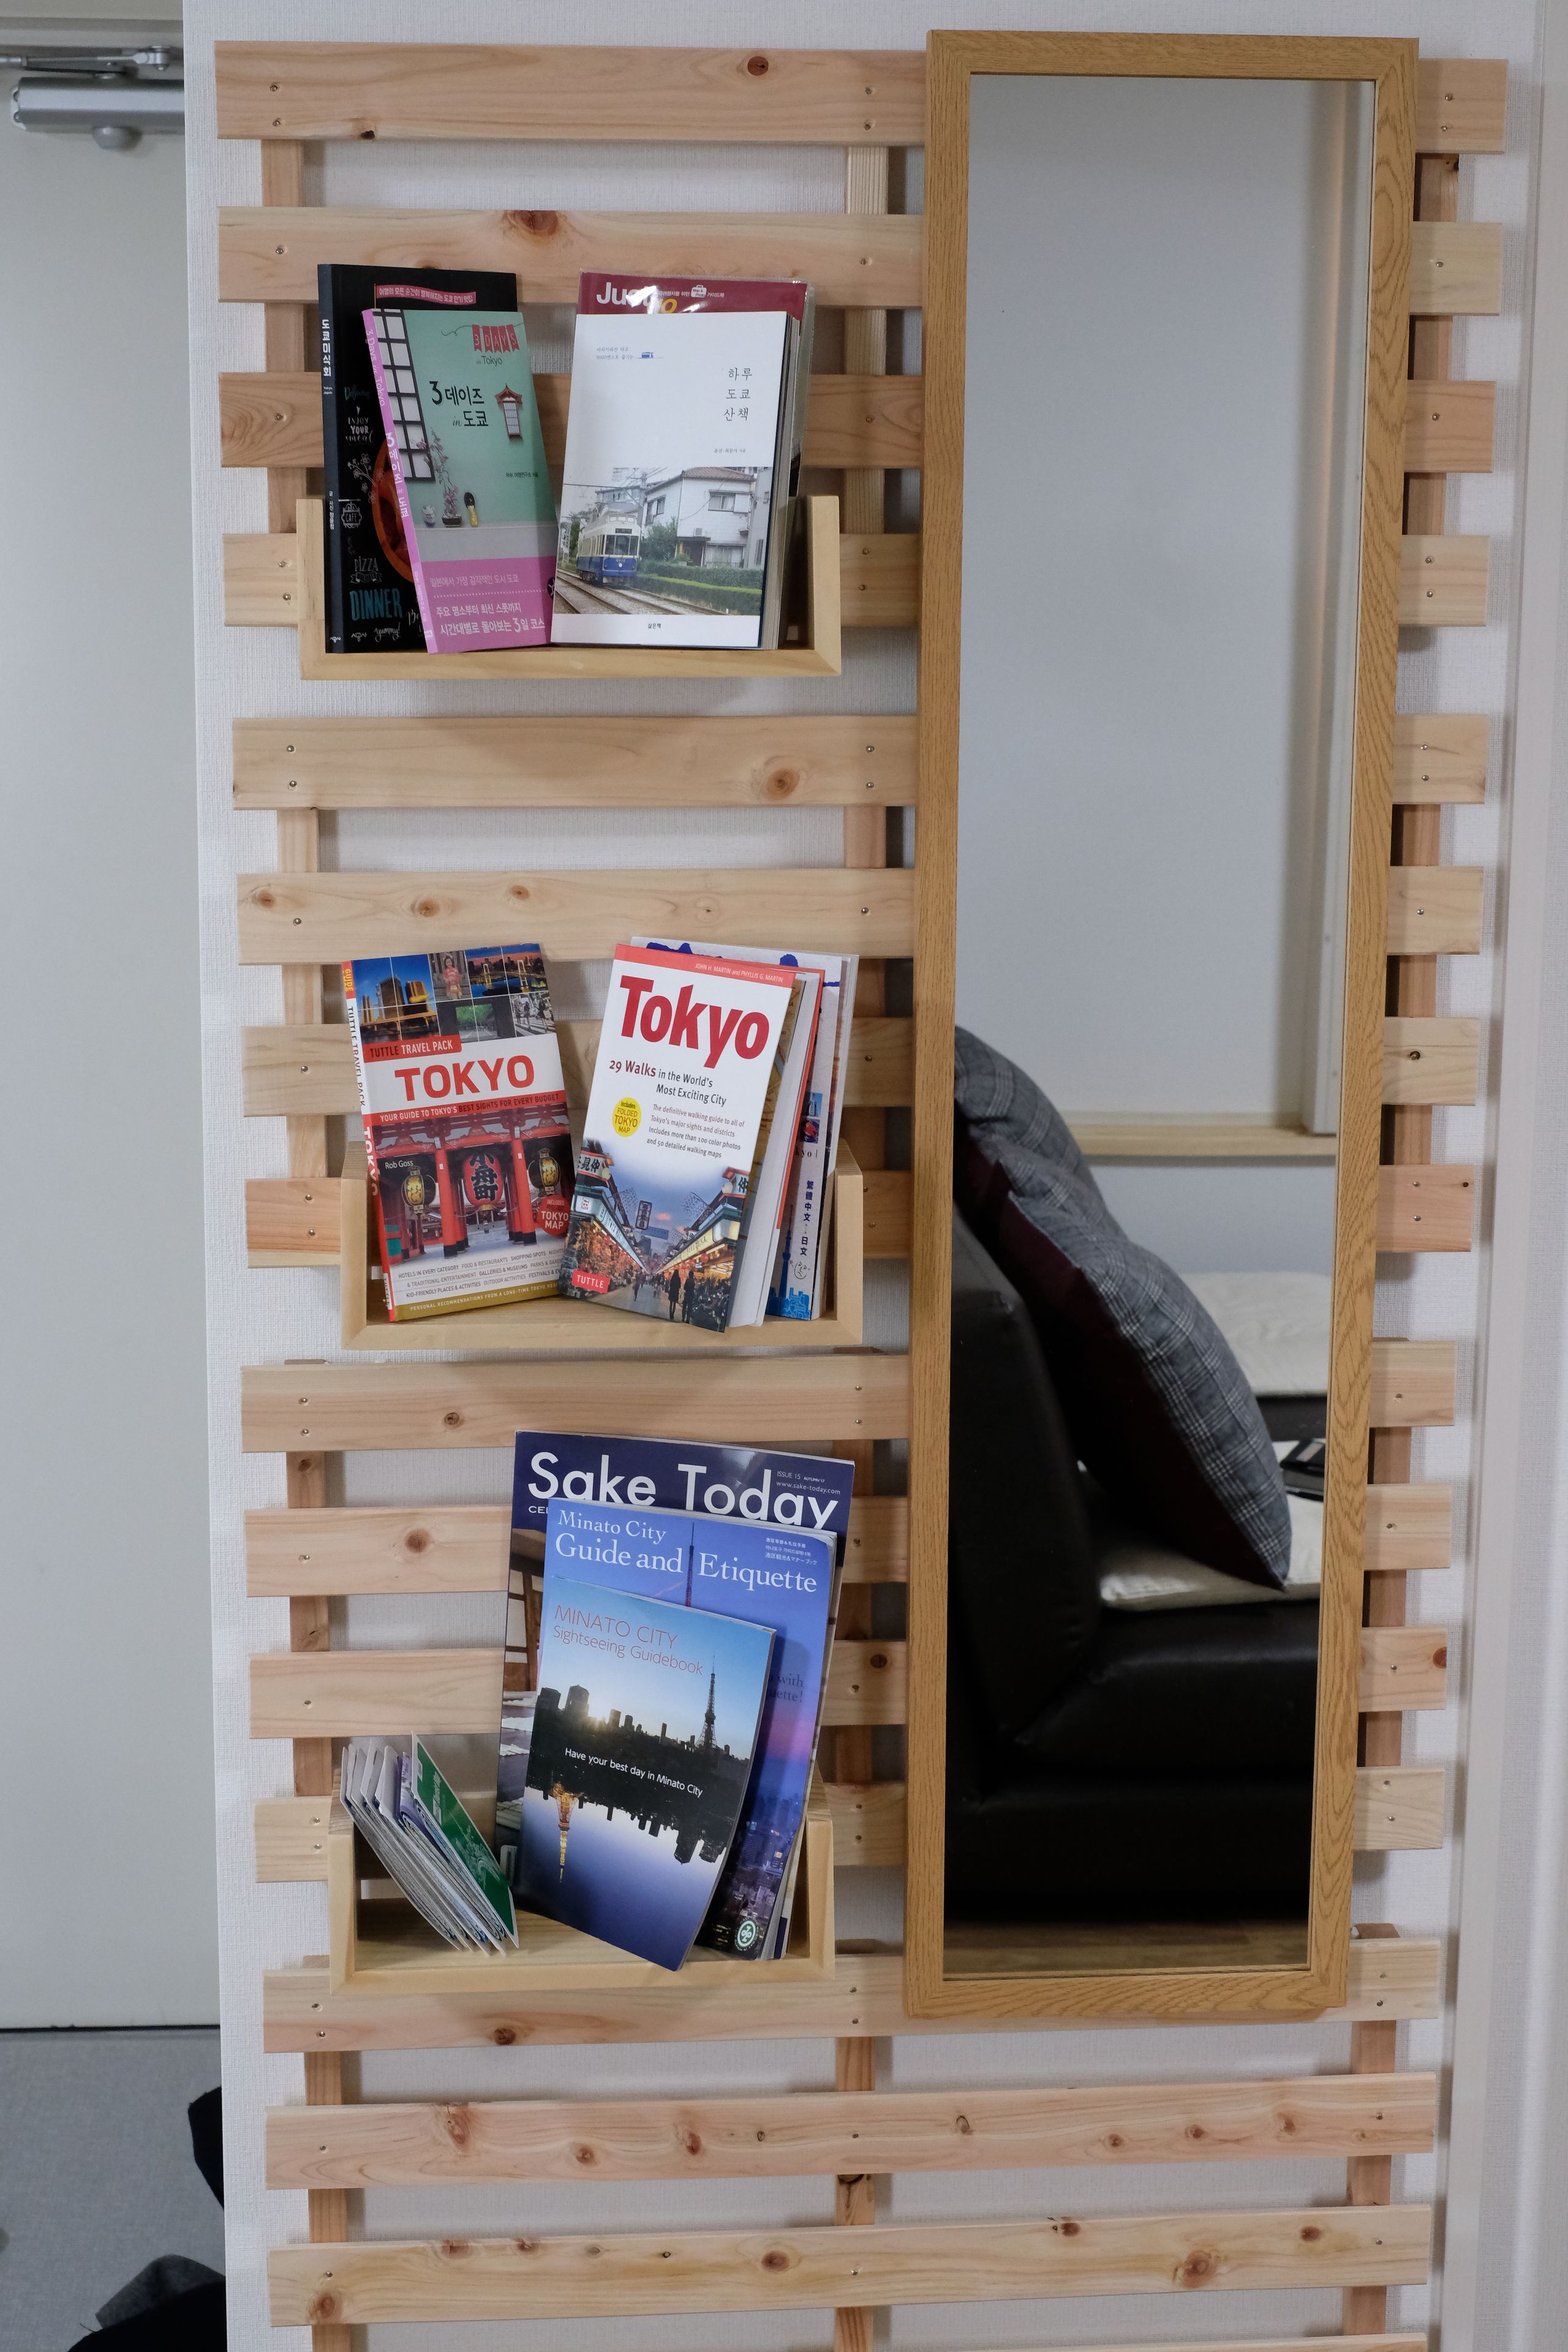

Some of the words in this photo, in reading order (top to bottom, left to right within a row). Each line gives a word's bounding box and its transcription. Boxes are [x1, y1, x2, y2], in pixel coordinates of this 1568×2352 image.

[475, 334, 480, 345] 3
[485, 334, 516, 346] DAYS
[368, 338, 377, 361] Days
[481, 356, 502, 366] Tokyo
[728, 368, 752, 381] 하루
[429, 381, 442, 405] 3
[445, 385, 484, 405] 데이즈
[726, 389, 750, 399] 도쿄
[453, 417, 461, 426] in
[464, 411, 488, 426] 도쿄
[723, 407, 748, 421] 산책
[350, 426, 369, 434] YOUR
[386, 432, 394, 447] 3
[389, 448, 403, 484] 데이즈
[431, 577, 454, 587] 일본에서
[456, 577, 468, 586] 가장
[469, 575, 492, 586] 감각적인
[350, 588, 402, 621] DINNER
[436, 606, 451, 617] 주요
[452, 605, 479, 616] 명소부터
[481, 604, 494, 614] 최신
[441, 622, 480, 636] 시간대별로
[481, 620, 512, 633] 돌아보는
[513, 618, 529, 633] 3일
[530, 618, 545, 628] 코스
[619, 975, 769, 1069] Tokyo
[370, 1046, 398, 1058] TUTTLE
[401, 1042, 431, 1055] TRAVEL
[432, 1040, 453, 1051] PACK
[394, 1055, 534, 1101] TOKYO
[609, 1060, 622, 1073] 29
[625, 1060, 657, 1077] Walks
[658, 1069, 666, 1079] in
[668, 1071, 680, 1082] the
[683, 1073, 713, 1088] World's
[514, 1097, 532, 1106] EVERY
[535, 1093, 559, 1102] BUDGET
[656, 1084, 676, 1096] Most
[677, 1087, 709, 1104] Exciting
[710, 1094, 726, 1107] City
[617, 1107, 638, 1117] FOLDED
[663, 1106, 687, 1117] definitive
[688, 1112, 708, 1121] walking
[614, 1115, 638, 1128] TOKYO
[651, 1115, 669, 1125] Tokyo's
[714, 1128, 735, 1137] districts
[649, 1126, 670, 1136] Includes
[722, 1142, 741, 1150] photos
[665, 1141, 686, 1151] detailed
[687, 1147, 707, 1156] walking
[803, 1180, 814, 1222] 繁體中文
[541, 1210, 568, 1221] TOKYO
[545, 1220, 564, 1230] MAP
[800, 1236, 809, 1256] 日文
[412, 1278, 440, 1287] TRADITIONAL
[441, 1272, 477, 1283] ENTERTAINMENT
[479, 1267, 502, 1276] GALLERIES
[577, 1275, 604, 1288] TUTTLE
[406, 1289, 437, 1297] KID-FRIENDLY
[437, 1295, 483, 1306] RECOMMENDATIONS
[527, 1452, 657, 1507] Sake
[677, 1463, 839, 1529] Today
[776, 1482, 840, 1494] www.sake-today.com
[557, 1509, 621, 1534] Minato
[625, 1520, 667, 1544] City
[555, 1533, 631, 1566] Guide
[636, 1548, 684, 1574] and
[697, 1552, 818, 1594] Etiquette
[554, 1604, 631, 1638] MINATO
[636, 1626, 678, 1650] CITY
[553, 1625, 627, 1659] Sightseeing
[630, 1646, 704, 1676] Guidebook
[778, 1673, 804, 1687] with
[565, 1747, 587, 1762] Have
[588, 1754, 608, 1766] your
[610, 1758, 628, 1773] best
[630, 1764, 646, 1779] day
[647, 1771, 655, 1781] in
[657, 1773, 685, 1790] Minato
[687, 1784, 704, 1798] City
